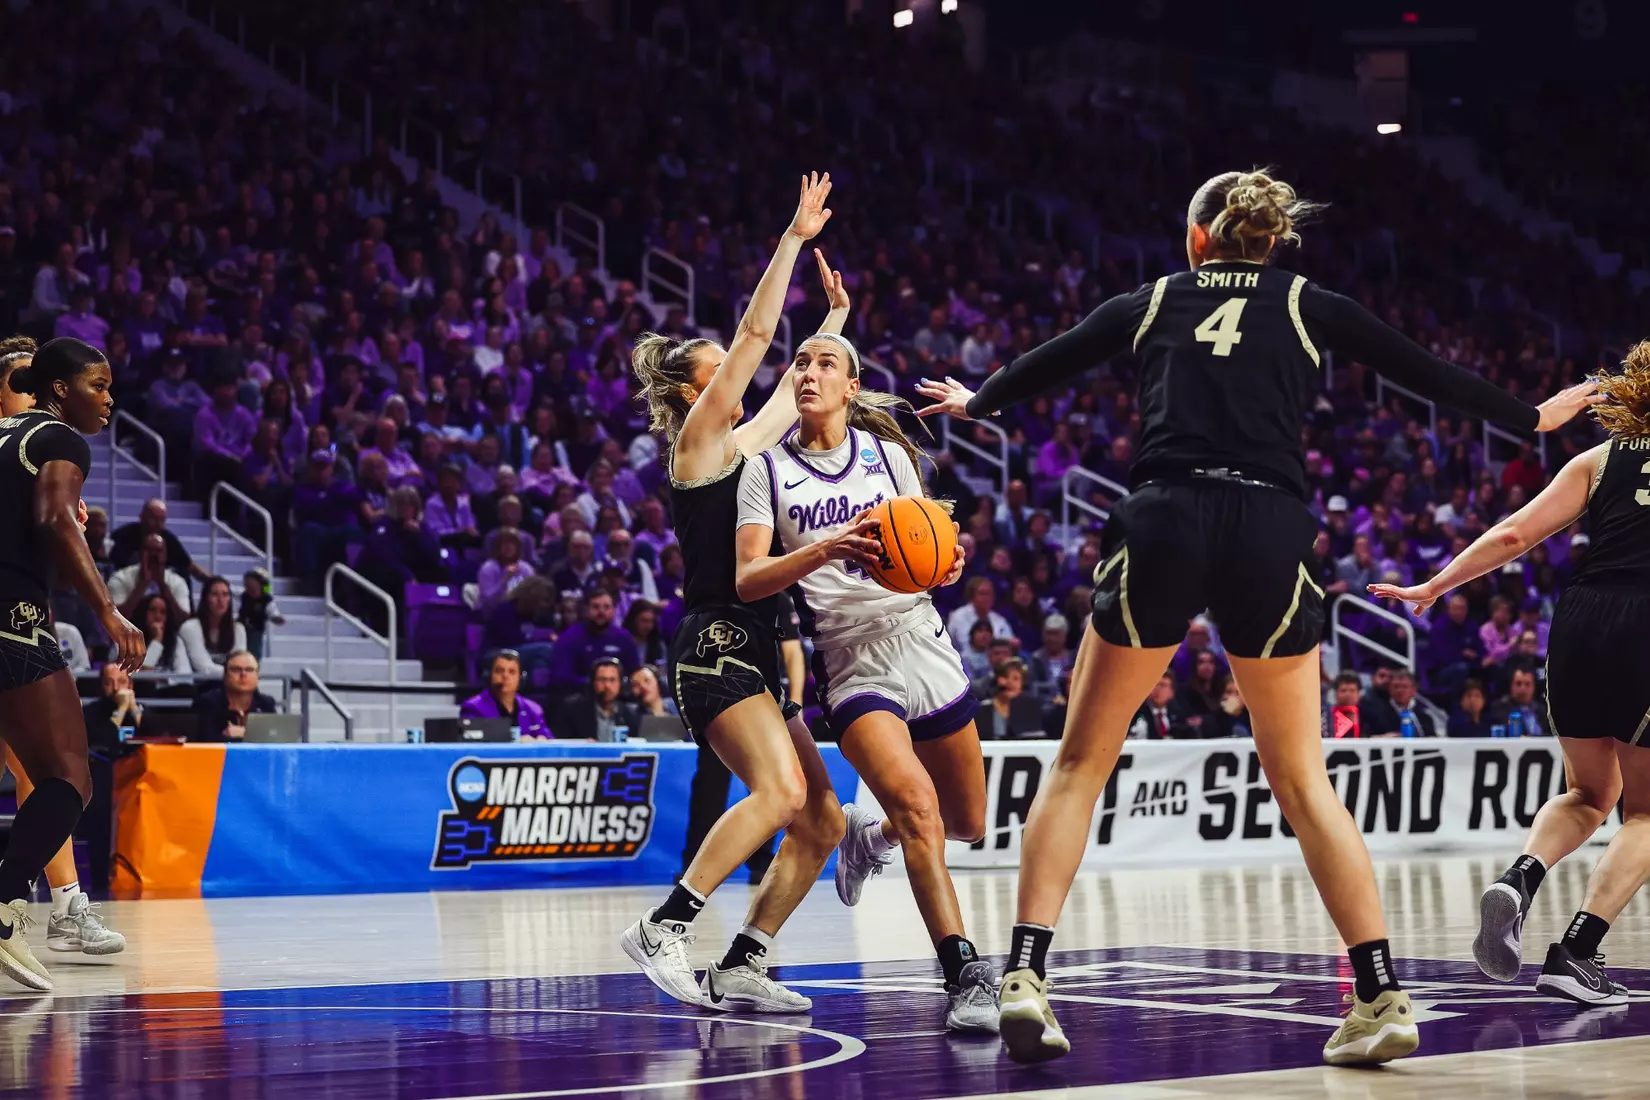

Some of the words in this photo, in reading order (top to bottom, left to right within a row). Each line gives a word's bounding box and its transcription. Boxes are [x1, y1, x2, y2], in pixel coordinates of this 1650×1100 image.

[1196, 271, 1260, 288] SMITH
[1194, 297, 1248, 357] 4
[486, 766, 599, 805] MARCH
[1130, 780, 1188, 817] AND
[1198, 748, 1446, 841] SEOND
[500, 805, 650, 845] MADNESS
